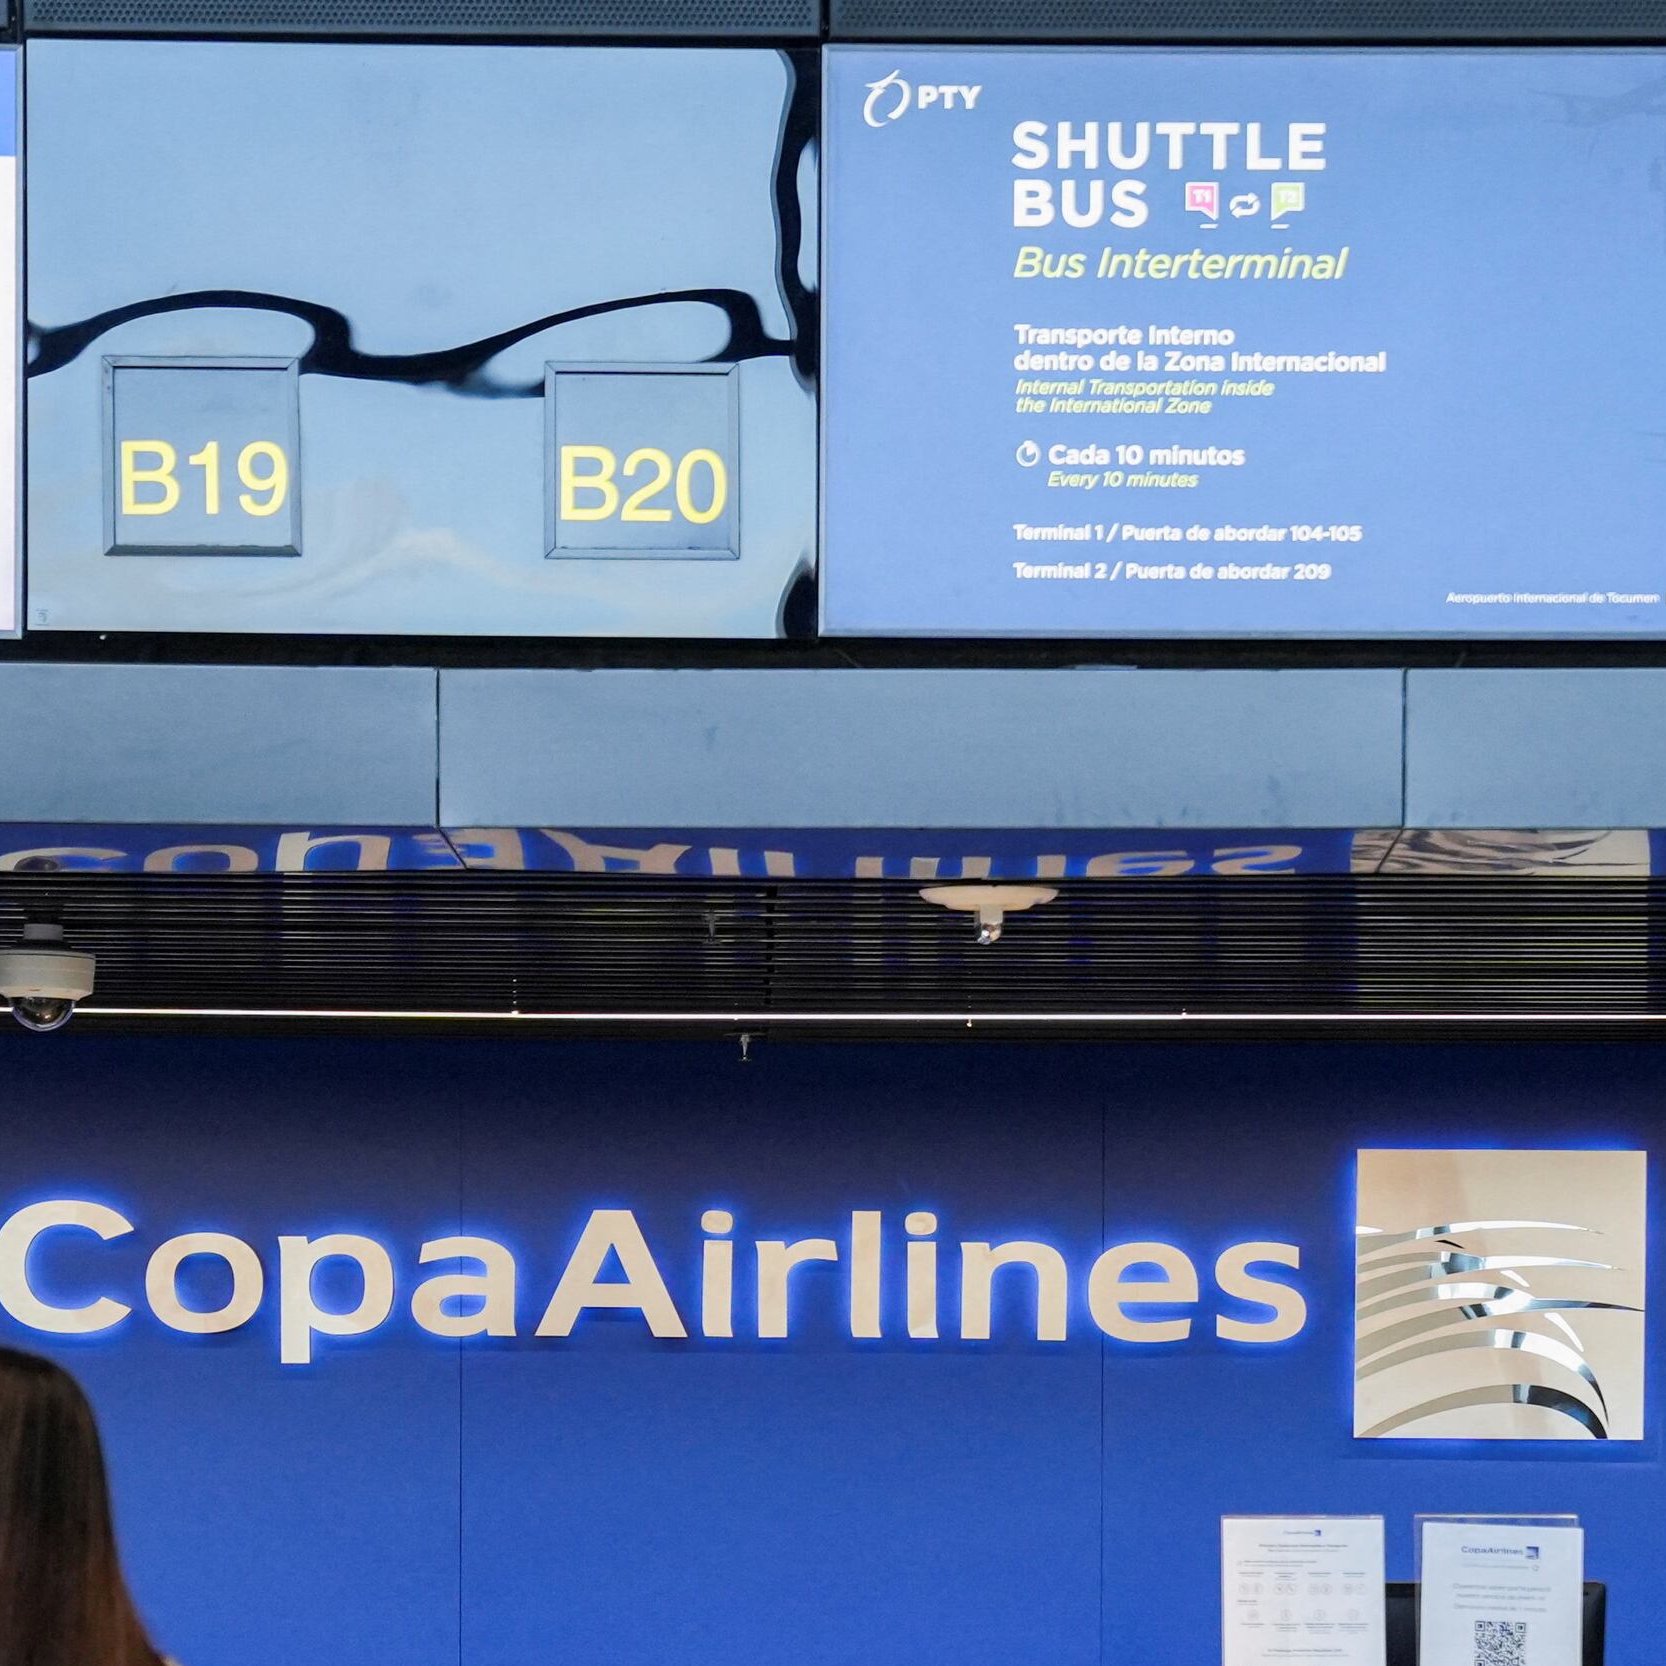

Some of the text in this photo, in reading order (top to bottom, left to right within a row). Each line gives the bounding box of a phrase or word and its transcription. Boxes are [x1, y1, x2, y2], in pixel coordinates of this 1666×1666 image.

[917, 85, 982, 110] PTY
[1012, 121, 1327, 170] SHUTTLE
[1013, 179, 1149, 228] BUS
[1013, 246, 1349, 280] Bus Interterminal
[1014, 325, 1235, 348] Transporte Interno
[1014, 351, 1387, 374] dentro de la Zona Internacional
[1015, 378, 1275, 398] Internal Transportation inside
[1015, 397, 1213, 414] the International Zone
[1048, 444, 1245, 467] Cada 10 minutos
[120, 440, 288, 517] B19
[560, 446, 728, 524] B20
[1047, 471, 1199, 490] Every 10 minutes
[1013, 524, 1091, 541] Terminal
[1094, 524, 1103, 541] 1
[1122, 525, 1182, 542] Puerta
[1186, 525, 1210, 542] de
[1214, 525, 1285, 542] abordar
[1290, 525, 1363, 542] 104-105
[1013, 562, 1092, 580] Terminal
[1094, 563, 1107, 580] 2
[1126, 563, 1185, 580] Puerta
[1189, 563, 1214, 580] de
[1217, 563, 1288, 580] abordar
[1294, 563, 1331, 580] 209
[1446, 592, 1511, 605] Aeropuerto
[1607, 592, 1660, 604] Tocumen
